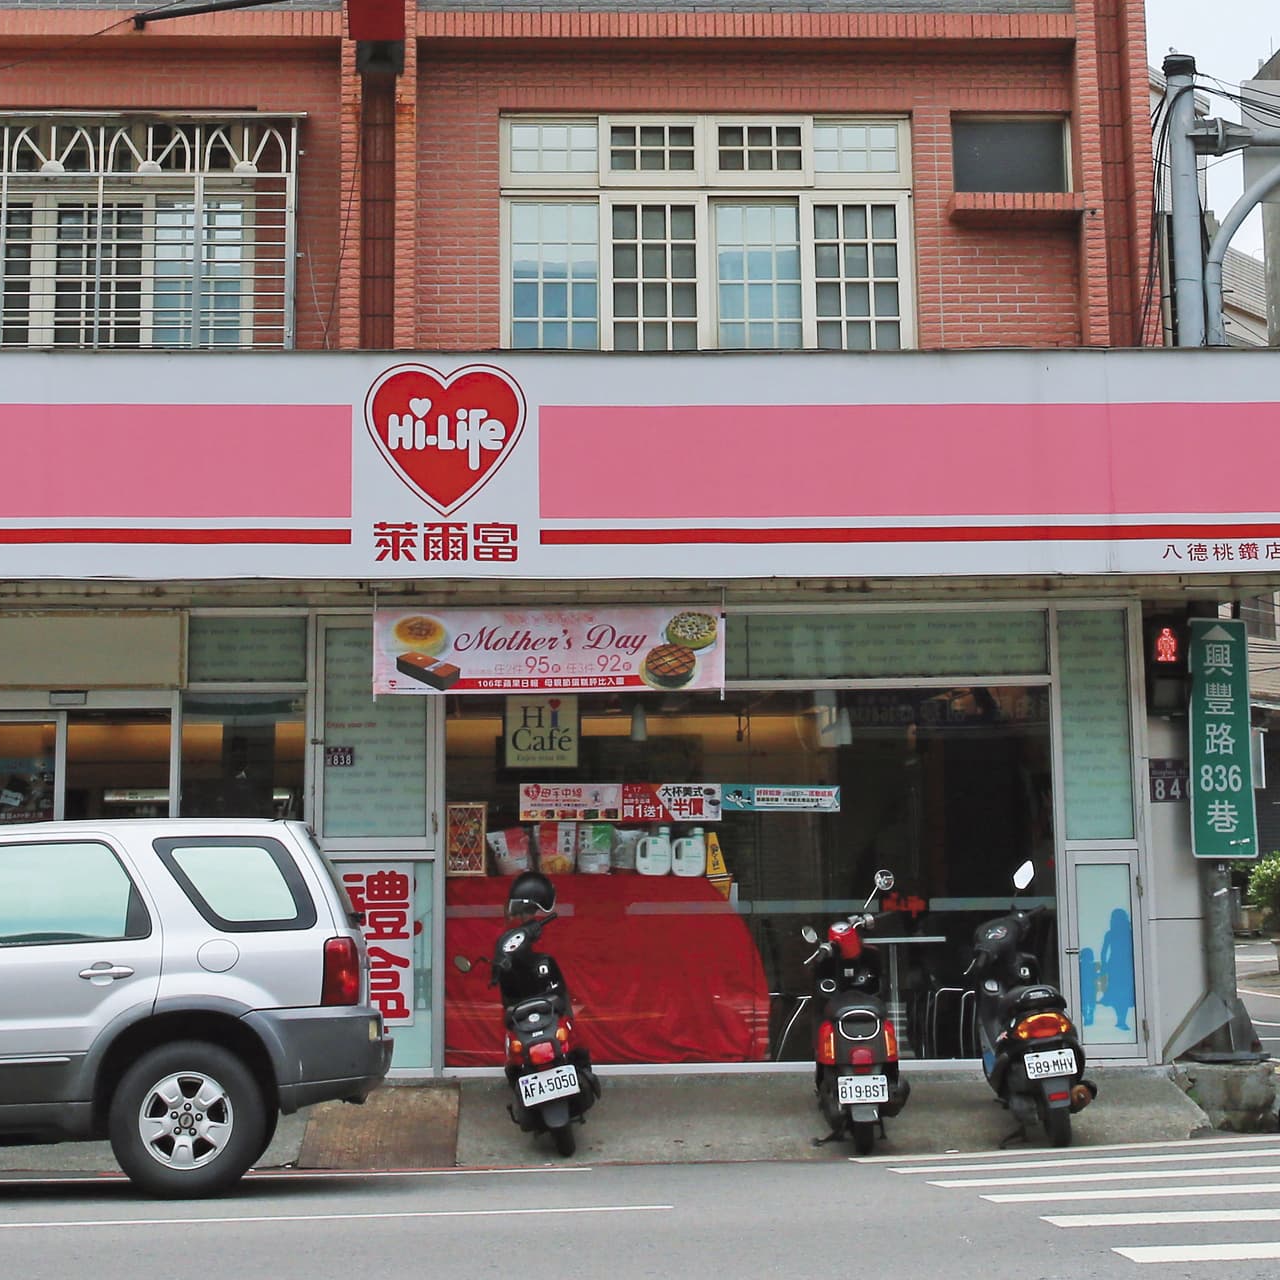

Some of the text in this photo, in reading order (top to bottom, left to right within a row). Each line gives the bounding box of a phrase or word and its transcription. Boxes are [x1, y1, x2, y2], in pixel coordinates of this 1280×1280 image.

[387, 398, 506, 470] Hi-Life
[373, 521, 518, 562] 萊爾富
[454, 623, 648, 656] Mother's Day
[521, 698, 561, 728] Hi
[511, 728, 572, 751] Café
[1200, 642, 1242, 833] 興豐路836巷
[333, 754, 351, 765] 838
[524, 1073, 577, 1100] AFA-5050
[840, 1083, 887, 1100] 819-BST
